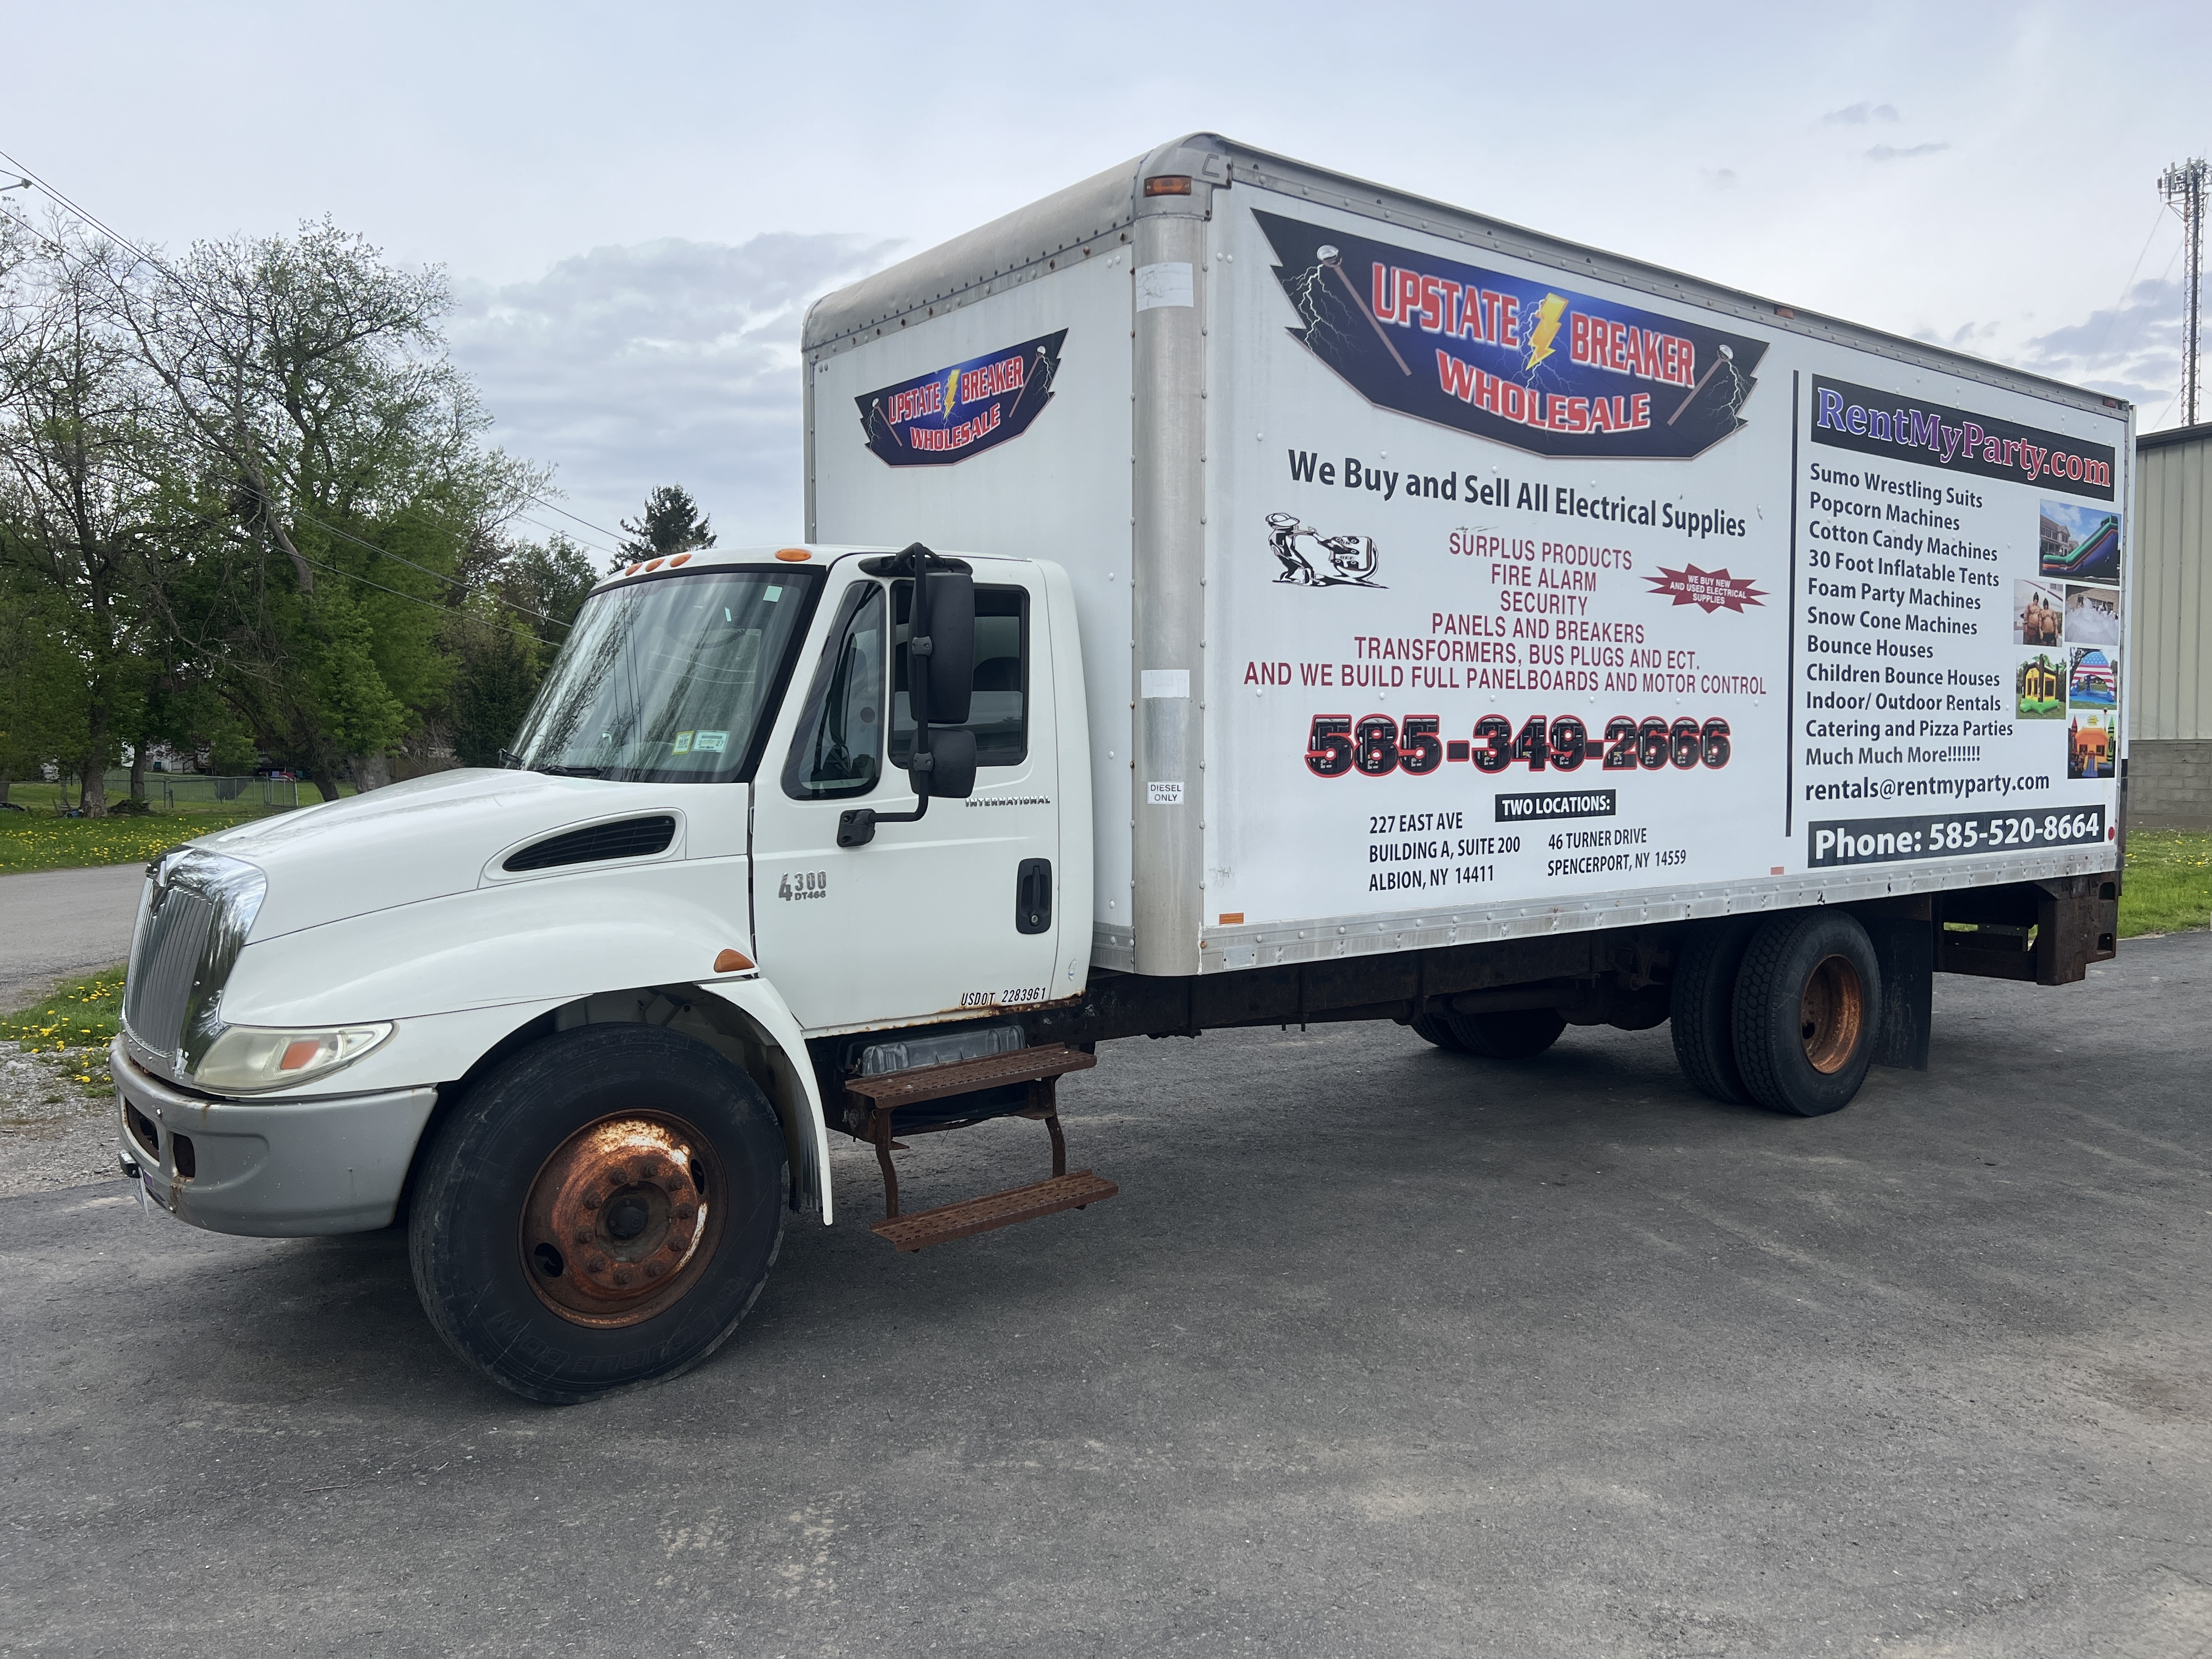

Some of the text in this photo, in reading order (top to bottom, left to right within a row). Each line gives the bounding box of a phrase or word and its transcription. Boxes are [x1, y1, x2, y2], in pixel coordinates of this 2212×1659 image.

[1371, 262, 1695, 388] UPSTATE BREAKER
[888, 356, 1024, 425] UPSTATE BREAKER
[1436, 348, 1651, 435] WHOLESALE
[910, 403, 1000, 451] WHOLESALE
[1816, 386, 2111, 487] RentMyParty.com
[1288, 449, 1746, 539] We Buy and Sell All Electrical Supplies
[1810, 462, 1983, 509] Sumo Wrestling Suits
[1810, 492, 1960, 531] Popcorn Machines
[1449, 533, 1632, 570] SURPLUS PRODUCTS
[1809, 520, 1997, 561] Cotton Candy Machines
[1492, 563, 1596, 592] FIRE ALARM
[1688, 575, 1731, 588] WE BUY NEW
[1809, 549, 1999, 587] 30 Foot Inflatable Tents
[1500, 590, 1588, 616] SECURITY
[1670, 582, 1747, 599] AND USED ELECTRICAL
[1693, 594, 1725, 604] SUPPLIES
[1808, 578, 1981, 610] Foam Party Machines
[1432, 613, 1644, 644] PANELS AND BREAKERS
[1808, 606, 1977, 635] Snow Cone Machines
[1355, 636, 1700, 670] TRANSFORMERS, BUS PLUGS AND ECT.
[1808, 635, 1933, 658] Bounce Houses
[1244, 662, 1766, 695] AND WE BUILD FULL PANELBOARDS AND MOTOR CONTROL
[1807, 663, 2000, 686] Children Bounce Houses
[1807, 691, 2001, 711] Indoor/ Outdoor Rentals
[1806, 720, 2013, 741] Catering and Pizza Parties
[1304, 713, 1732, 778] 585-349-2666
[1806, 746, 1980, 765] Much Much More!!!!!!!
[965, 795, 1050, 808] INTERNATIONAL
[1806, 774, 2049, 800] rentals@rentmyparty.com
[1502, 794, 1611, 816] TWO LOCATIONS:
[1370, 812, 1463, 834] 227 EAST AVE
[1815, 812, 2099, 860] Phone: 585-520-8664
[1369, 837, 1520, 862] BUILDING A, SUITE 200
[1548, 828, 1647, 850] 46 TURNER DRIVE
[1547, 850, 1686, 877] SPENCERPORT, NY 14559
[778, 870, 827, 901] 4300
[1369, 866, 1494, 892] ALBION, NY 14411
[795, 890, 826, 901] DT466
[961, 988, 1046, 1007] USDOT 2283961
